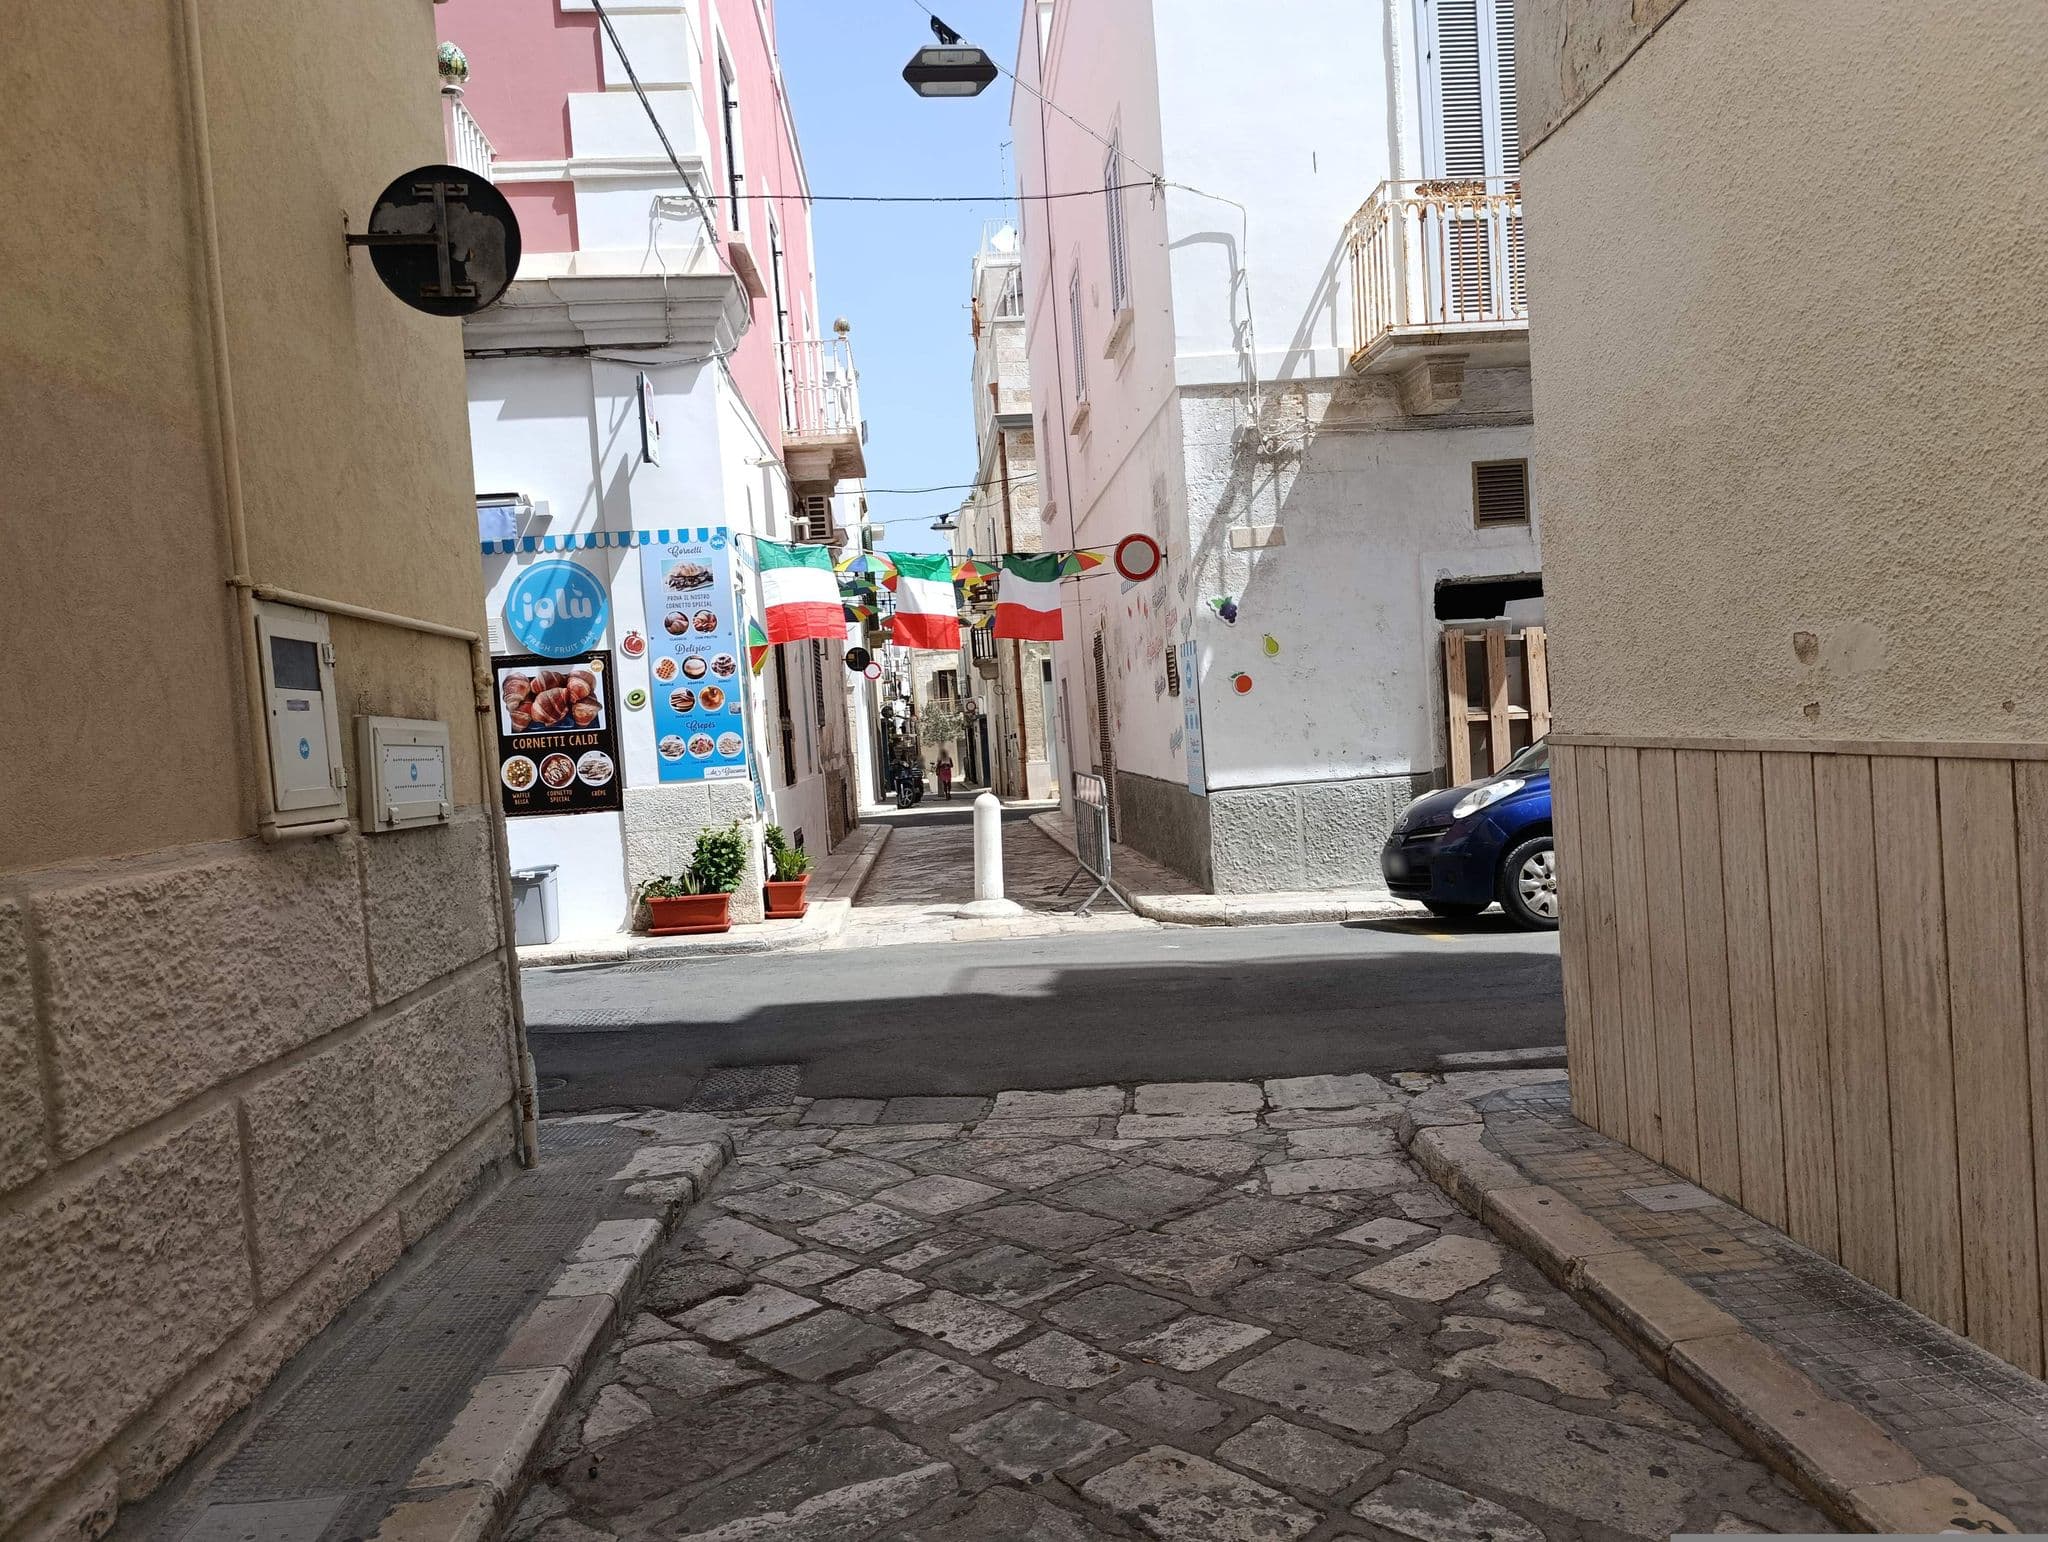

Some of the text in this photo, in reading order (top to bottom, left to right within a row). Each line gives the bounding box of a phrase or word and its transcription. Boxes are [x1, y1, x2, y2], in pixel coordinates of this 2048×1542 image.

[667, 546, 702, 558] Cornetti
[522, 583, 593, 629] iglù
[526, 631, 595, 653] FRESH FRUIT BAR
[513, 734, 599, 750] CORNETTI CALDI
